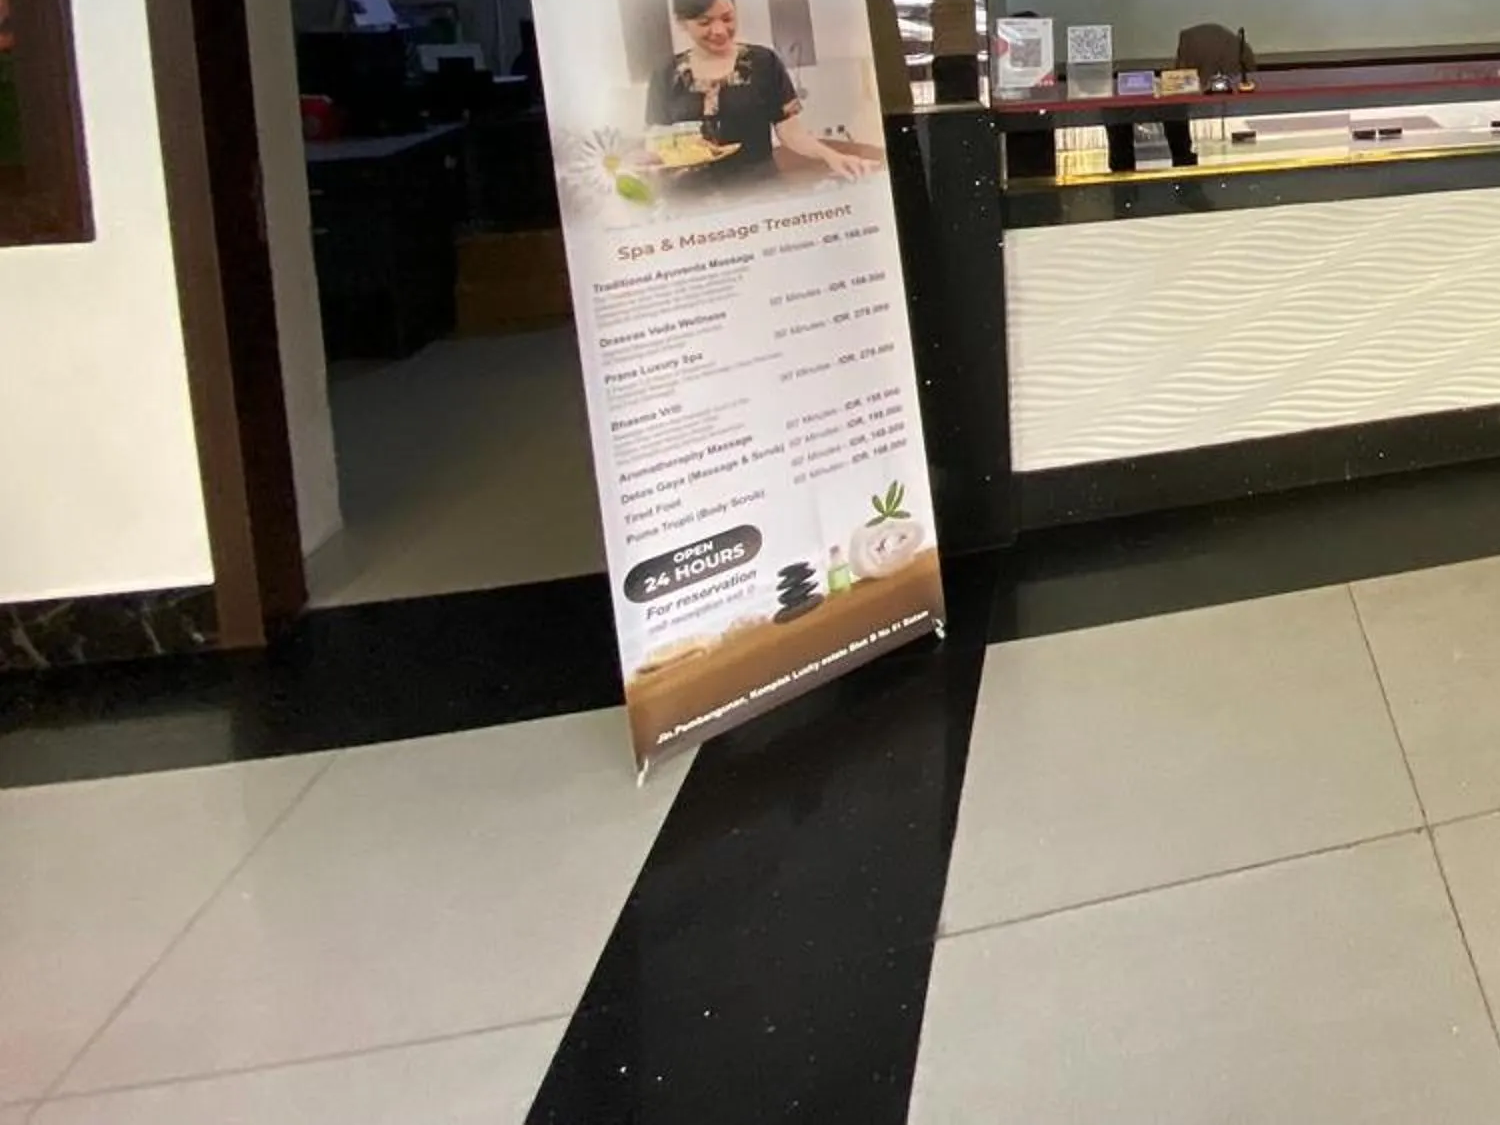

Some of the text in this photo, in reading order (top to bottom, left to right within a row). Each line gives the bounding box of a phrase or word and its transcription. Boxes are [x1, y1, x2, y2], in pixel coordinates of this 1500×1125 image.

[617, 204, 852, 261] Spa & Massage Treatment
[592, 272, 652, 293] Traditional
[709, 253, 755, 269] Massage
[707, 434, 753, 456] Massage
[644, 542, 746, 594] 24 HOURS
[673, 540, 714, 564] OPEN
[646, 568, 758, 620] For reservation
